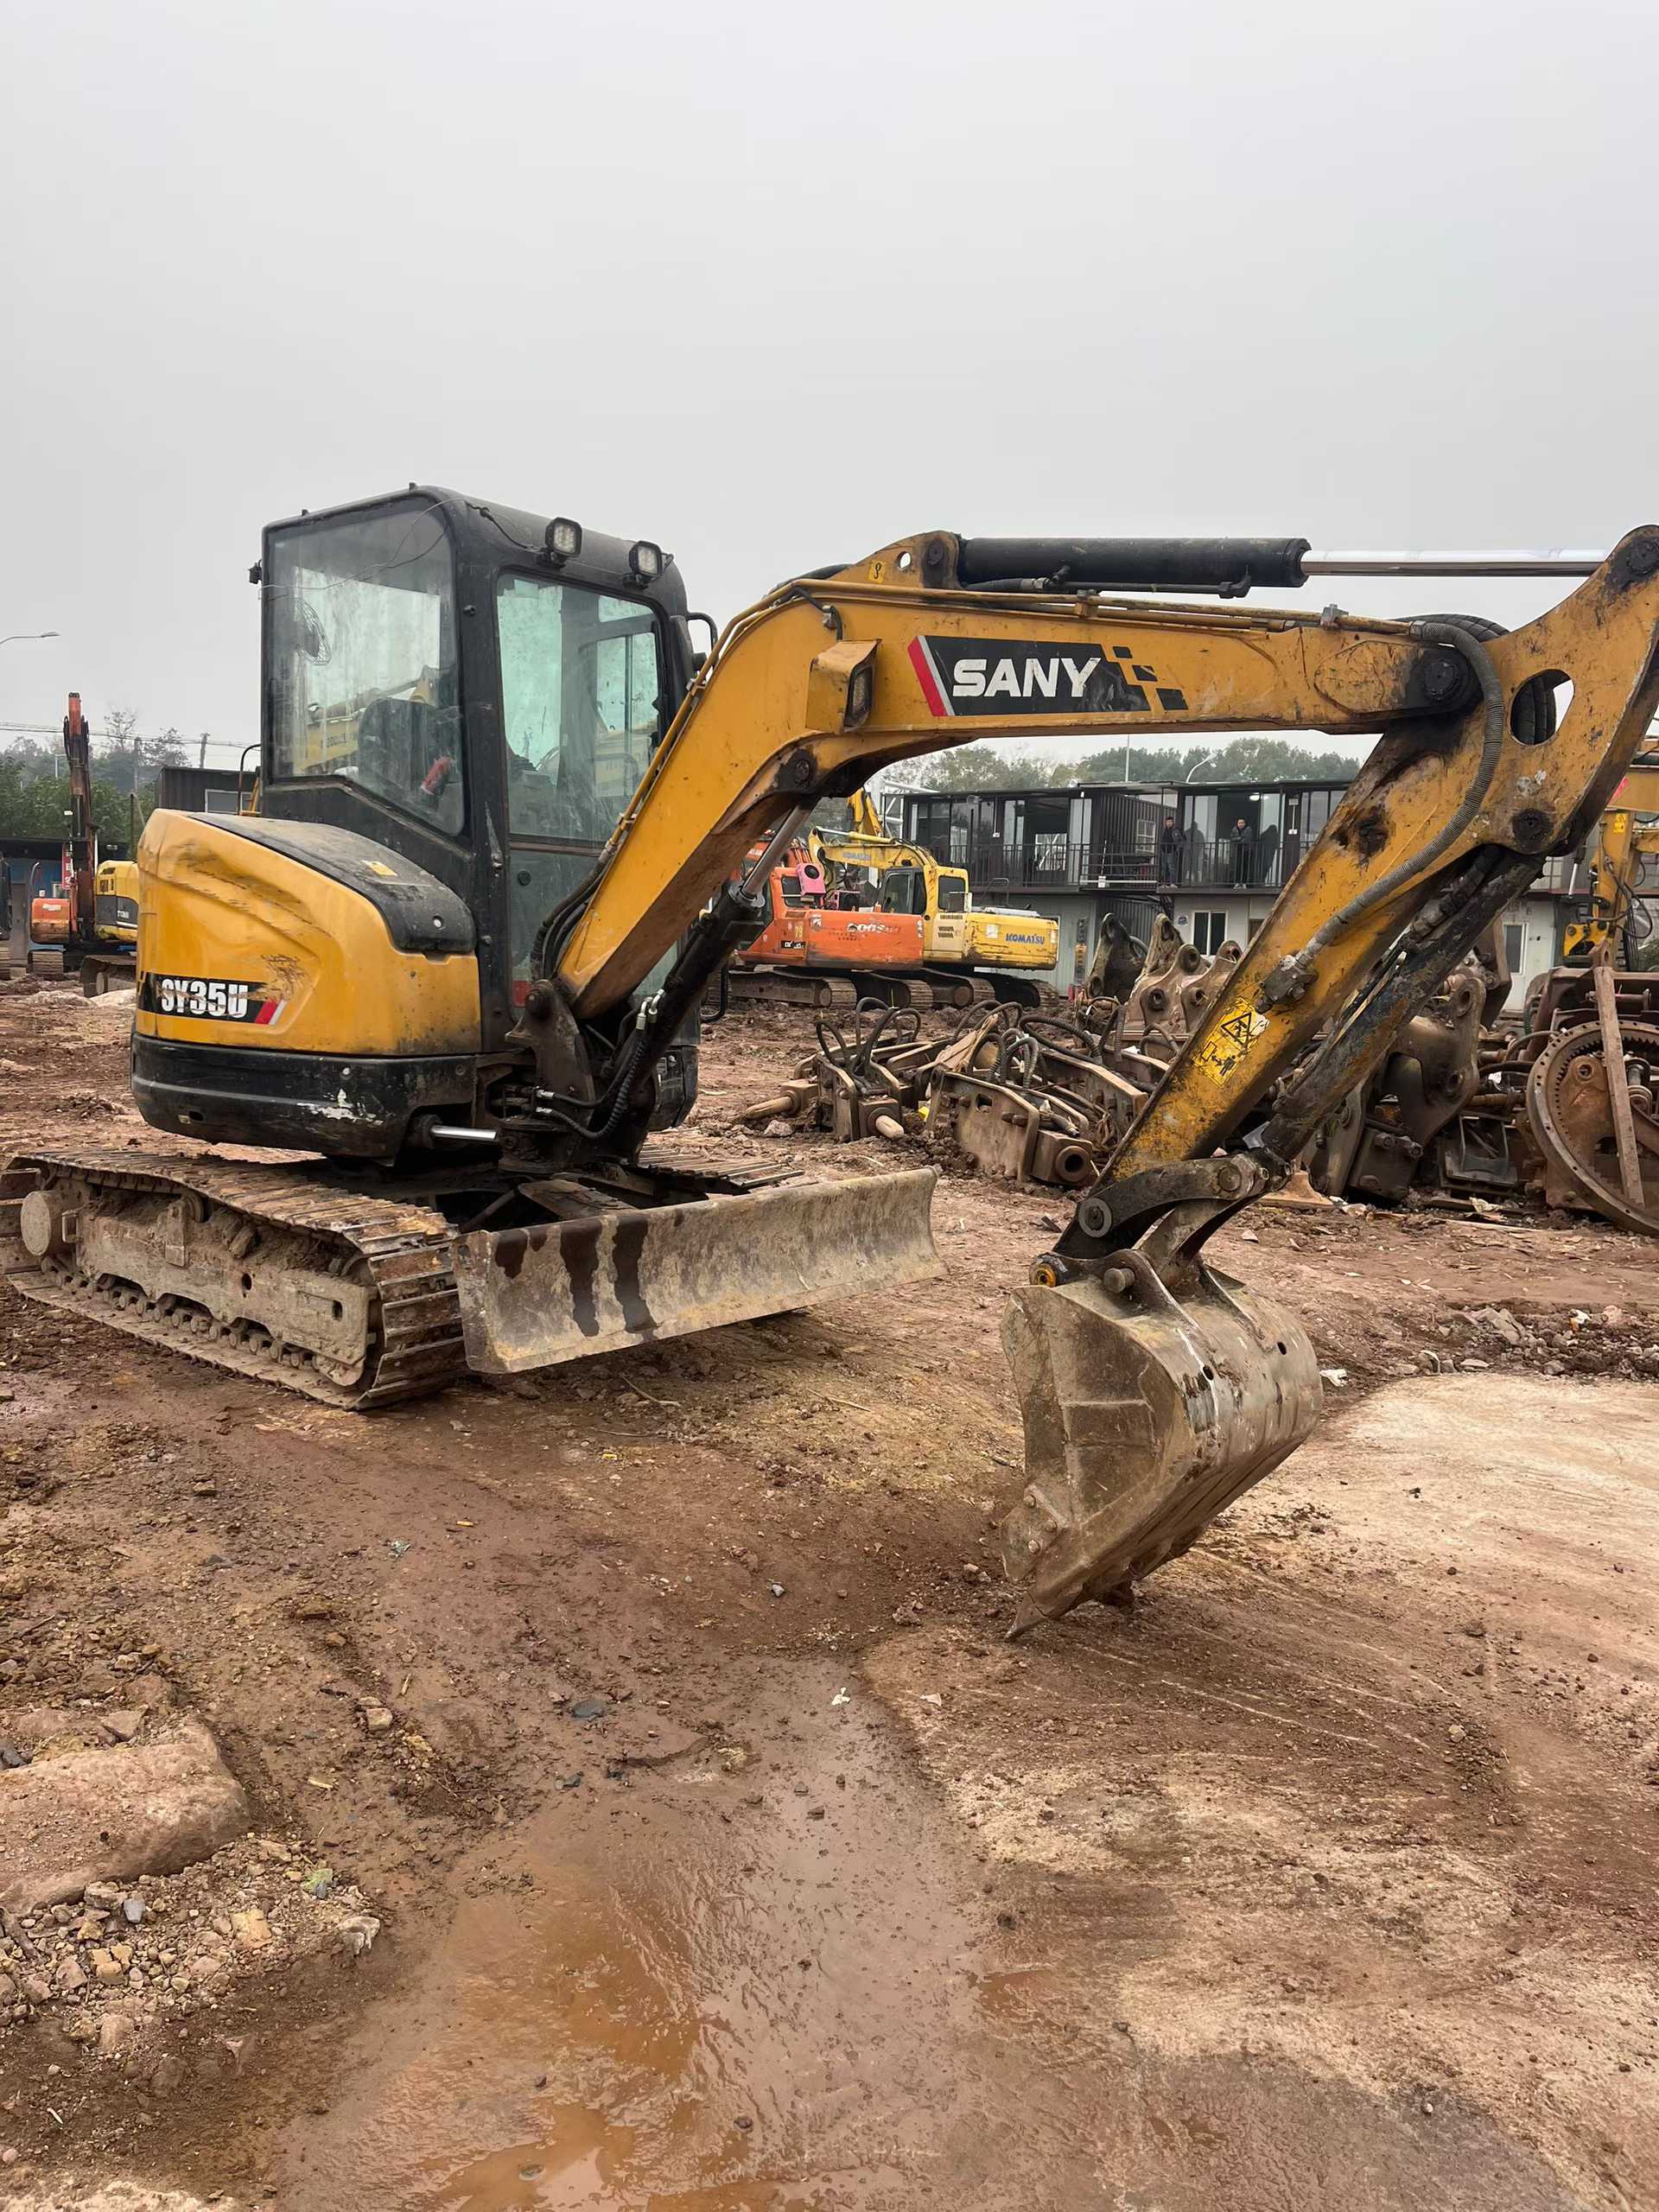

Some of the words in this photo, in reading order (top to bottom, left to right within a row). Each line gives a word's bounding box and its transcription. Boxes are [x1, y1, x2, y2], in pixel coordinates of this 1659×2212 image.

[952, 658, 1101, 697] SANY
[1005, 932, 1046, 945] KOMATSU
[161, 978, 249, 1019] SY35U
